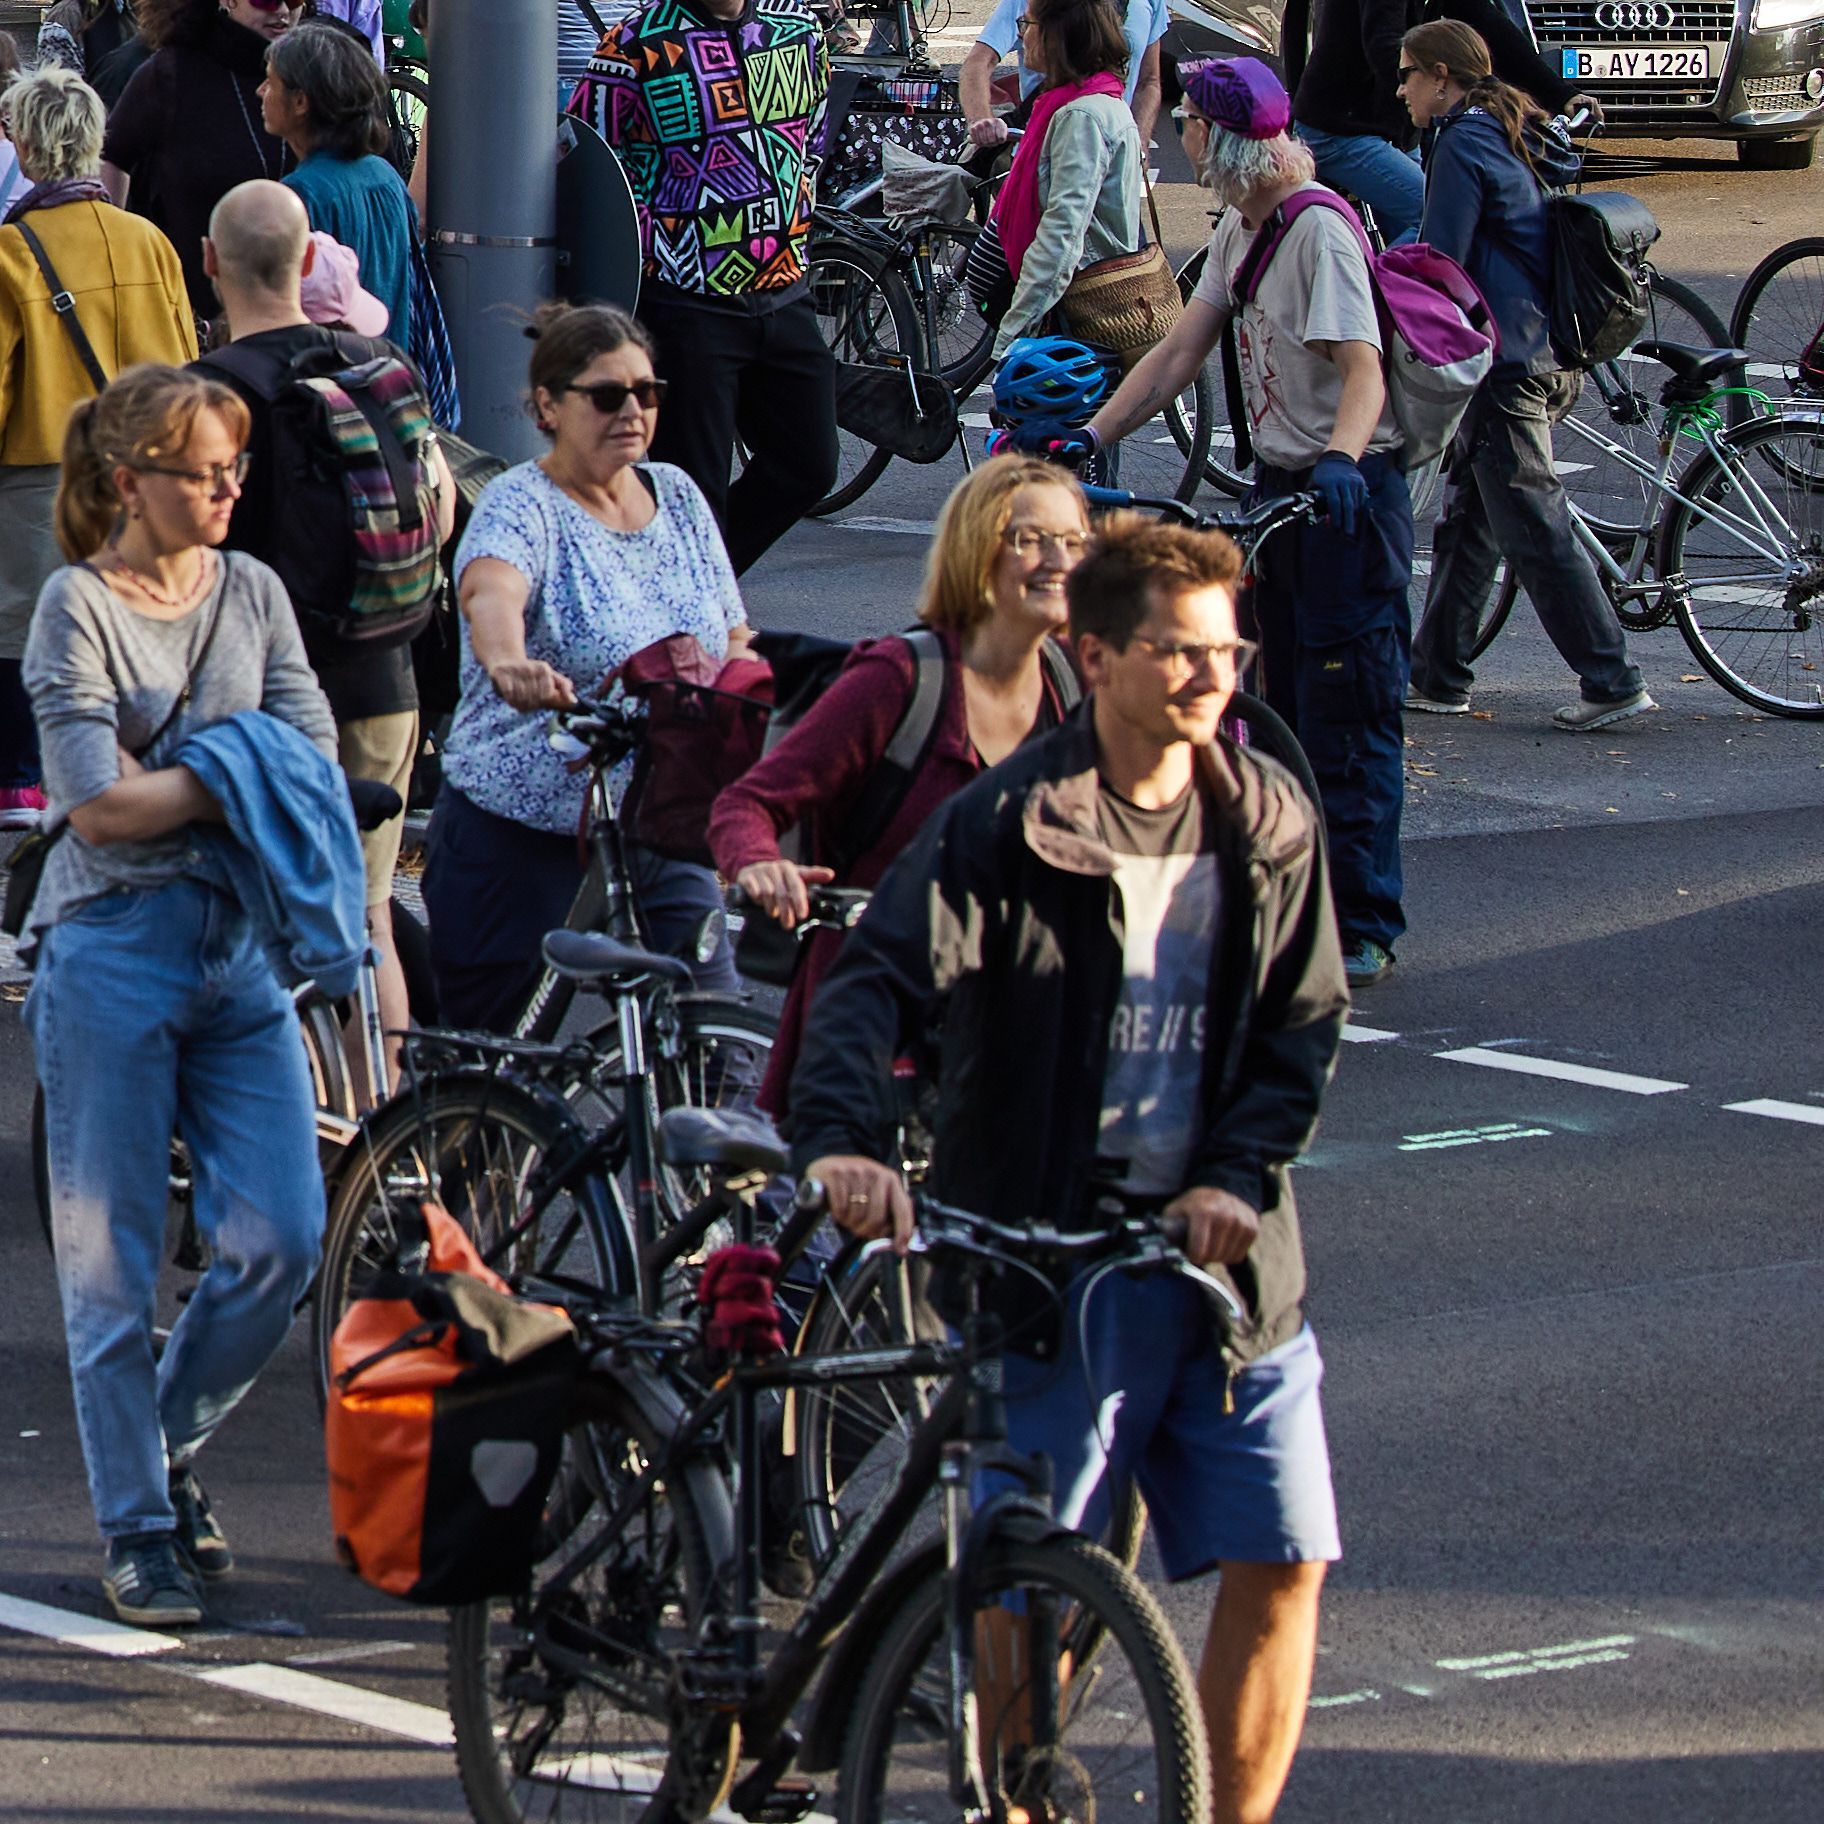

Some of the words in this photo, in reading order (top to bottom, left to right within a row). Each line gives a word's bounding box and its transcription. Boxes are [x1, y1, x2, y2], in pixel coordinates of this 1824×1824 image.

[1578, 53, 1593, 76] B
[1609, 53, 1640, 76] AY
[1644, 53, 1703, 76] 1226
